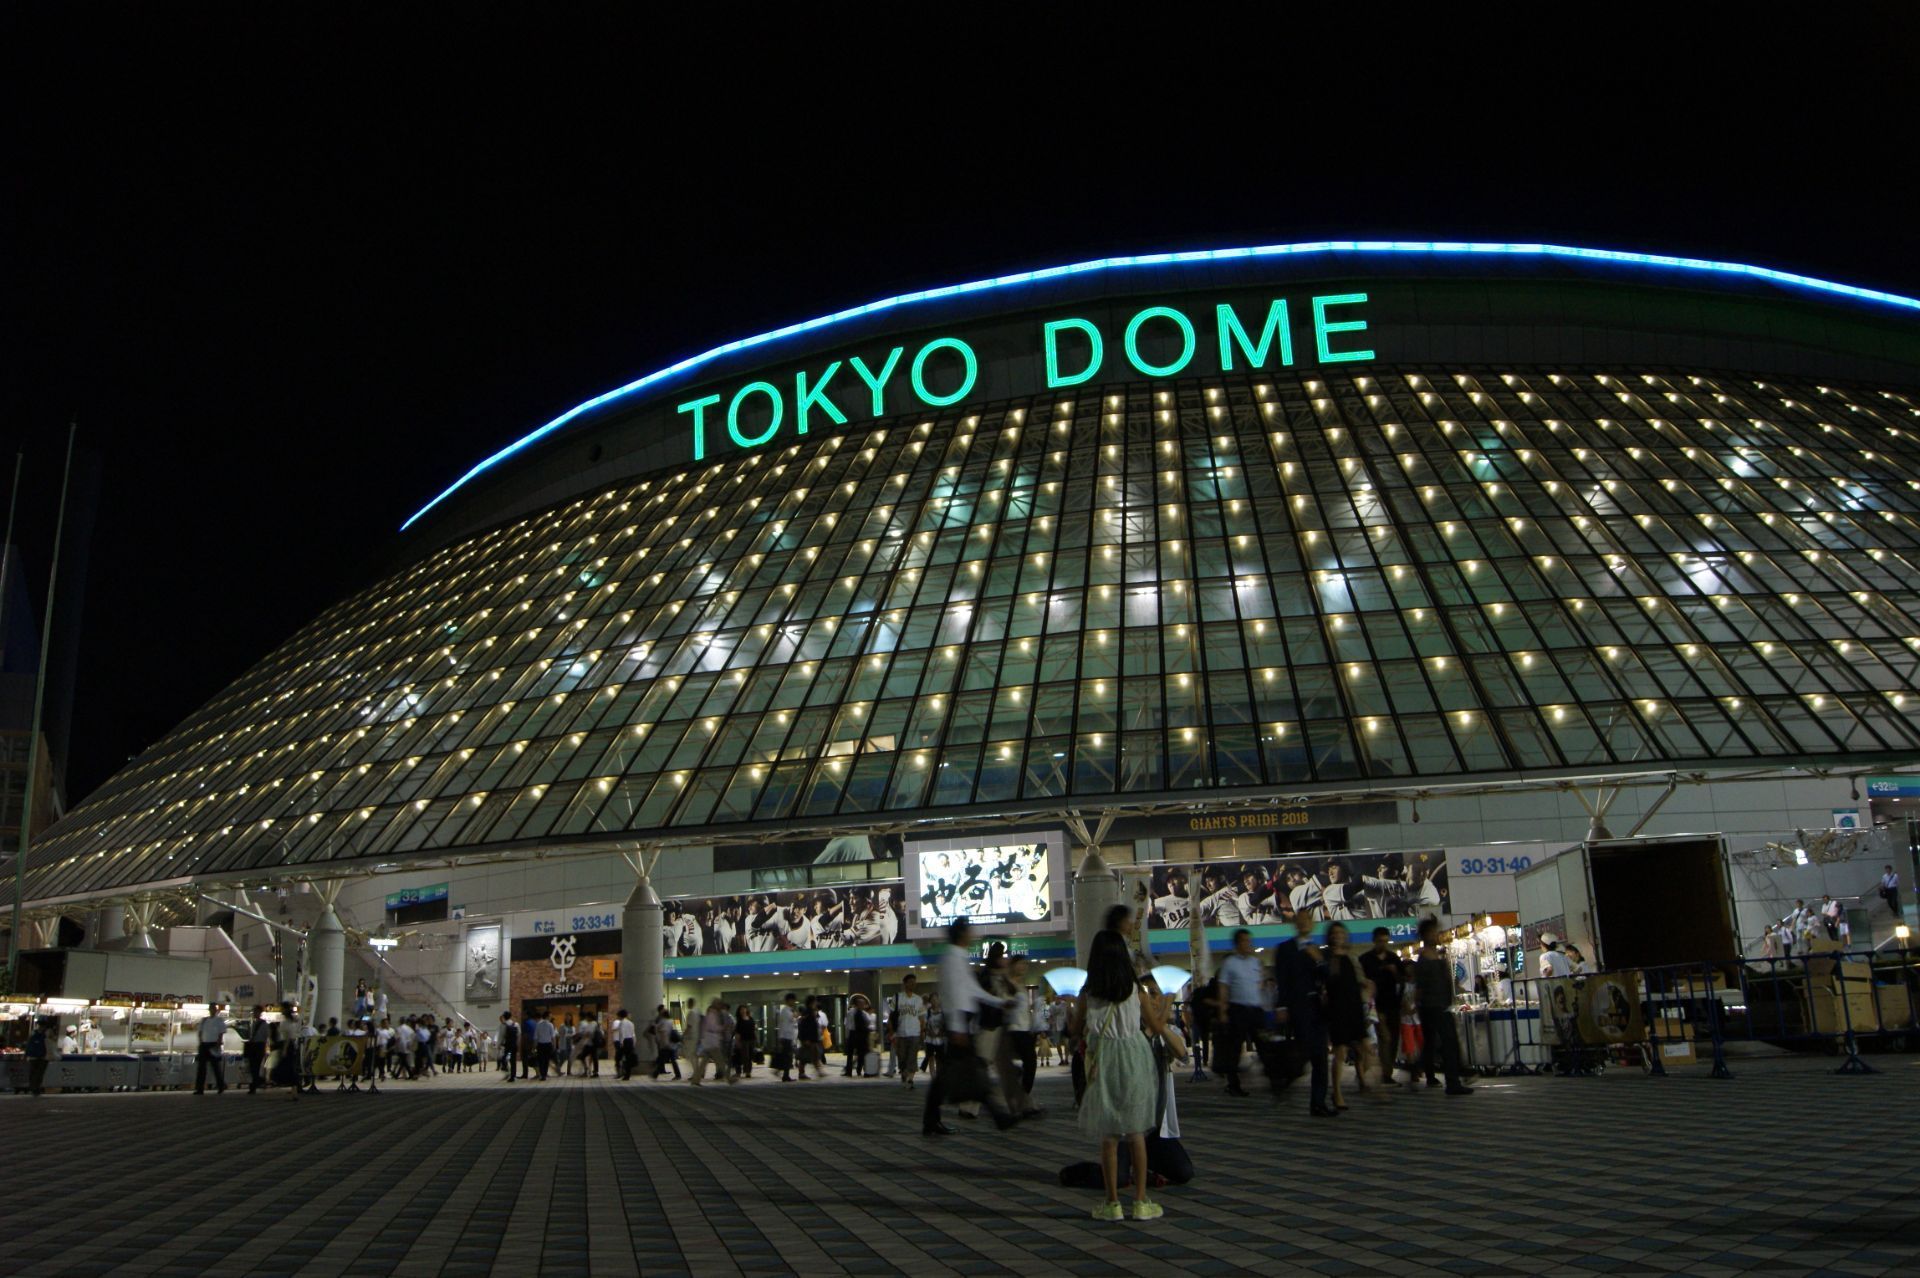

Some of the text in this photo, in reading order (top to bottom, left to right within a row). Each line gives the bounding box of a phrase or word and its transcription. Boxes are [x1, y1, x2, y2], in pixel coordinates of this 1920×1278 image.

[677, 293, 1377, 461] TOKYO DOME
[1878, 782, 1889, 791] 32
[1190, 811, 1309, 831] GIANTS PRIDE 2018
[402, 890, 418, 903] 32
[1011, 949, 1029, 957] GATE
